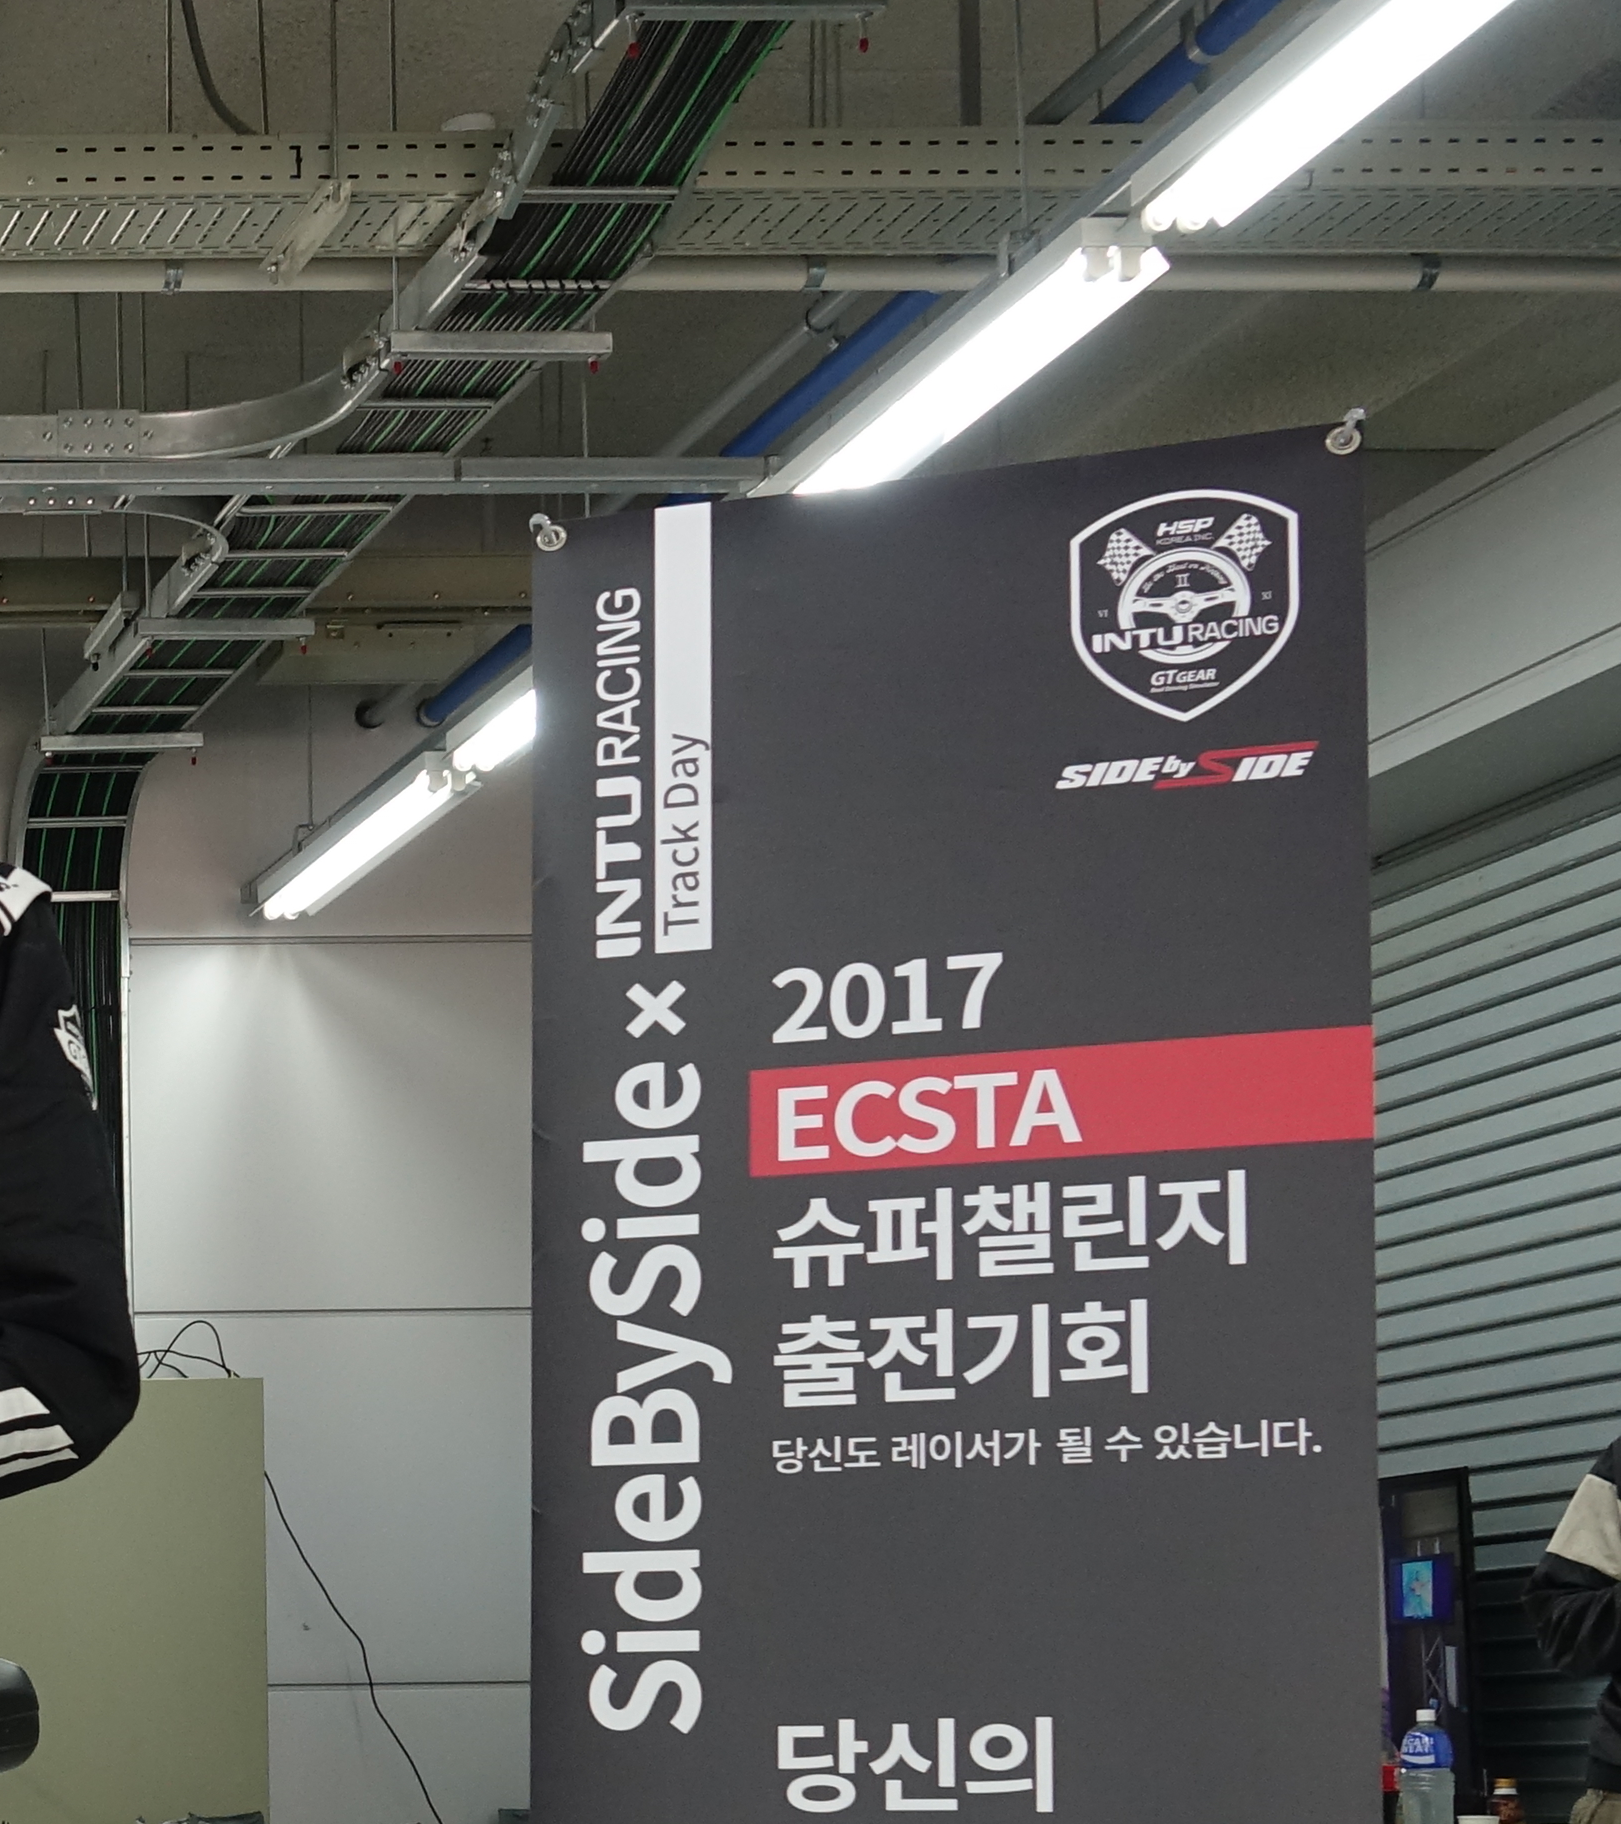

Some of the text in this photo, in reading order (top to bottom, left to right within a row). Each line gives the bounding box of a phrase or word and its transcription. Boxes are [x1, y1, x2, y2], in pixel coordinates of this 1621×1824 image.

[1156, 516, 1215, 536] HSP
[595, 586, 642, 768] RACING
[1091, 614, 1280, 654] INTU RACING
[595, 775, 642, 959] INTU
[660, 732, 710, 937] Track Day
[771, 952, 1004, 1044] 2017
[776, 1068, 1083, 1162] ECSTA
[772, 1169, 1248, 1290] 슈퍼챌린지
[580, 1061, 733, 1735] SideBySide
[772, 1298, 1149, 1408] 출전기회
[772, 1417, 1323, 1475] 당신도 레이서가 될 수 있습니다.
[775, 1716, 1054, 1814] 당신의
